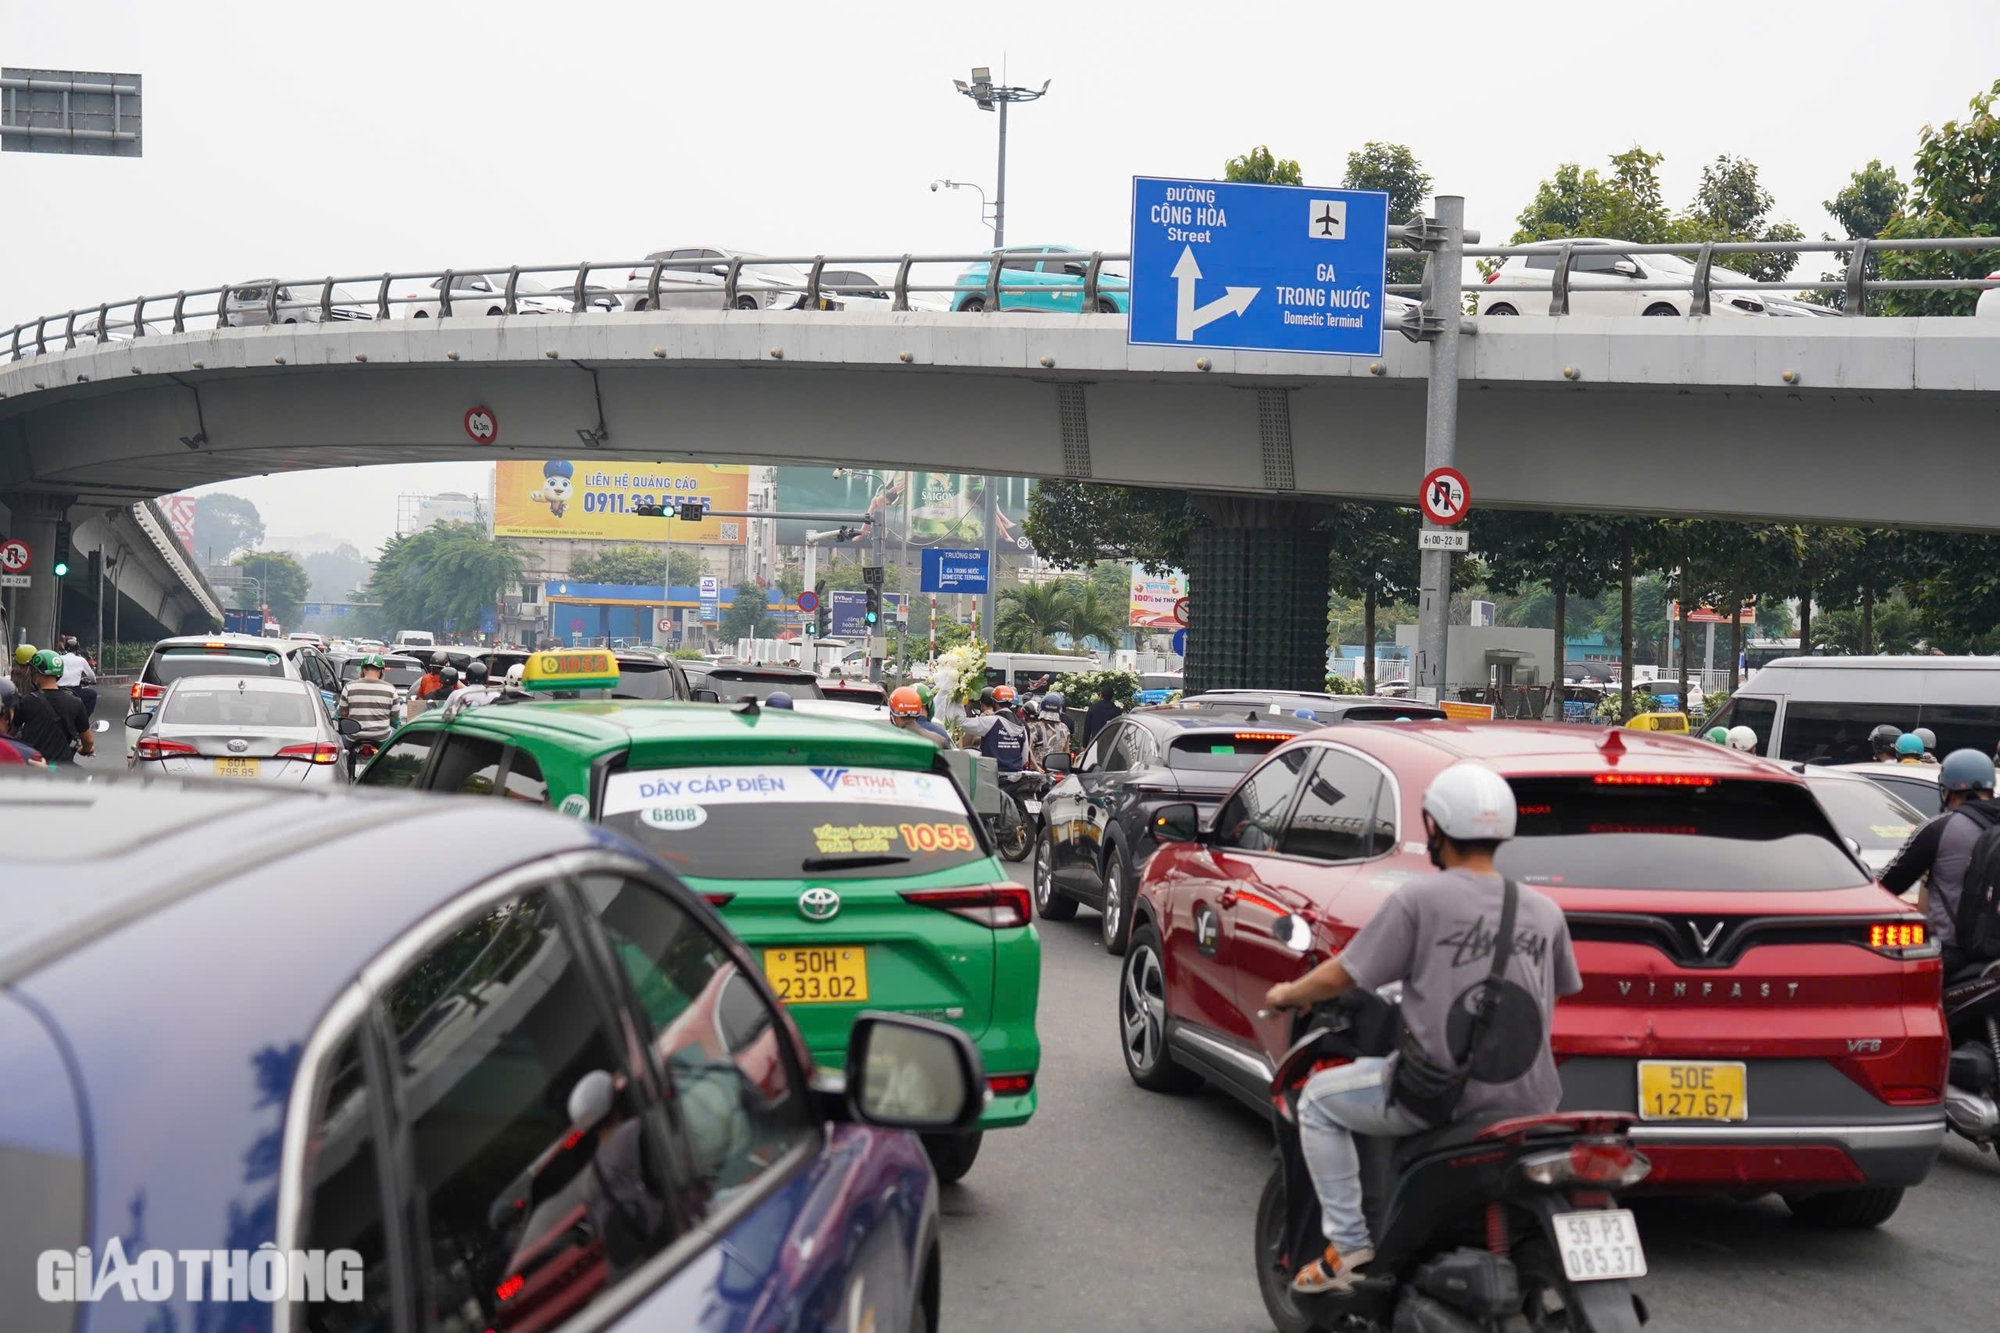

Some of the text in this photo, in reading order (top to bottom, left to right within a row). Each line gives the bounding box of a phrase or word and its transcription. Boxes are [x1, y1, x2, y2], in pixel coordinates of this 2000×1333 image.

[1166, 185, 1215, 204] ĐƯỜNG
[1151, 204, 1227, 227] CỘNG HÒA
[1168, 228, 1211, 243] Street
[1316, 264, 1335, 282] GA
[1276, 286, 1370, 309] TRONG NƯỚC
[1284, 311, 1363, 328] Domestic Terminal
[585, 473, 697, 490] LIÊN HỆ QUẢNG CÁO
[921, 491, 955, 501] SAIGON
[944, 551, 981, 560] TRƯỜNG SƠN
[968, 567, 979, 575] NƯỚC
[1134, 594, 1154, 602] 100%
[558, 656, 607, 673] 1055
[220, 768, 254, 777] 795.85
[640, 774, 786, 798] DÂY CÁP ĐIỆN
[652, 808, 697, 823] 6808
[899, 823, 974, 851] 1055
[794, 951, 837, 973] 50H
[778, 977, 856, 999] 233.02
[1619, 981, 1799, 997] VINFAST
[1670, 1067, 1714, 1090] 50E
[1656, 1094, 1733, 1116] 127.67
[1568, 1246, 1636, 1275] 085.37
